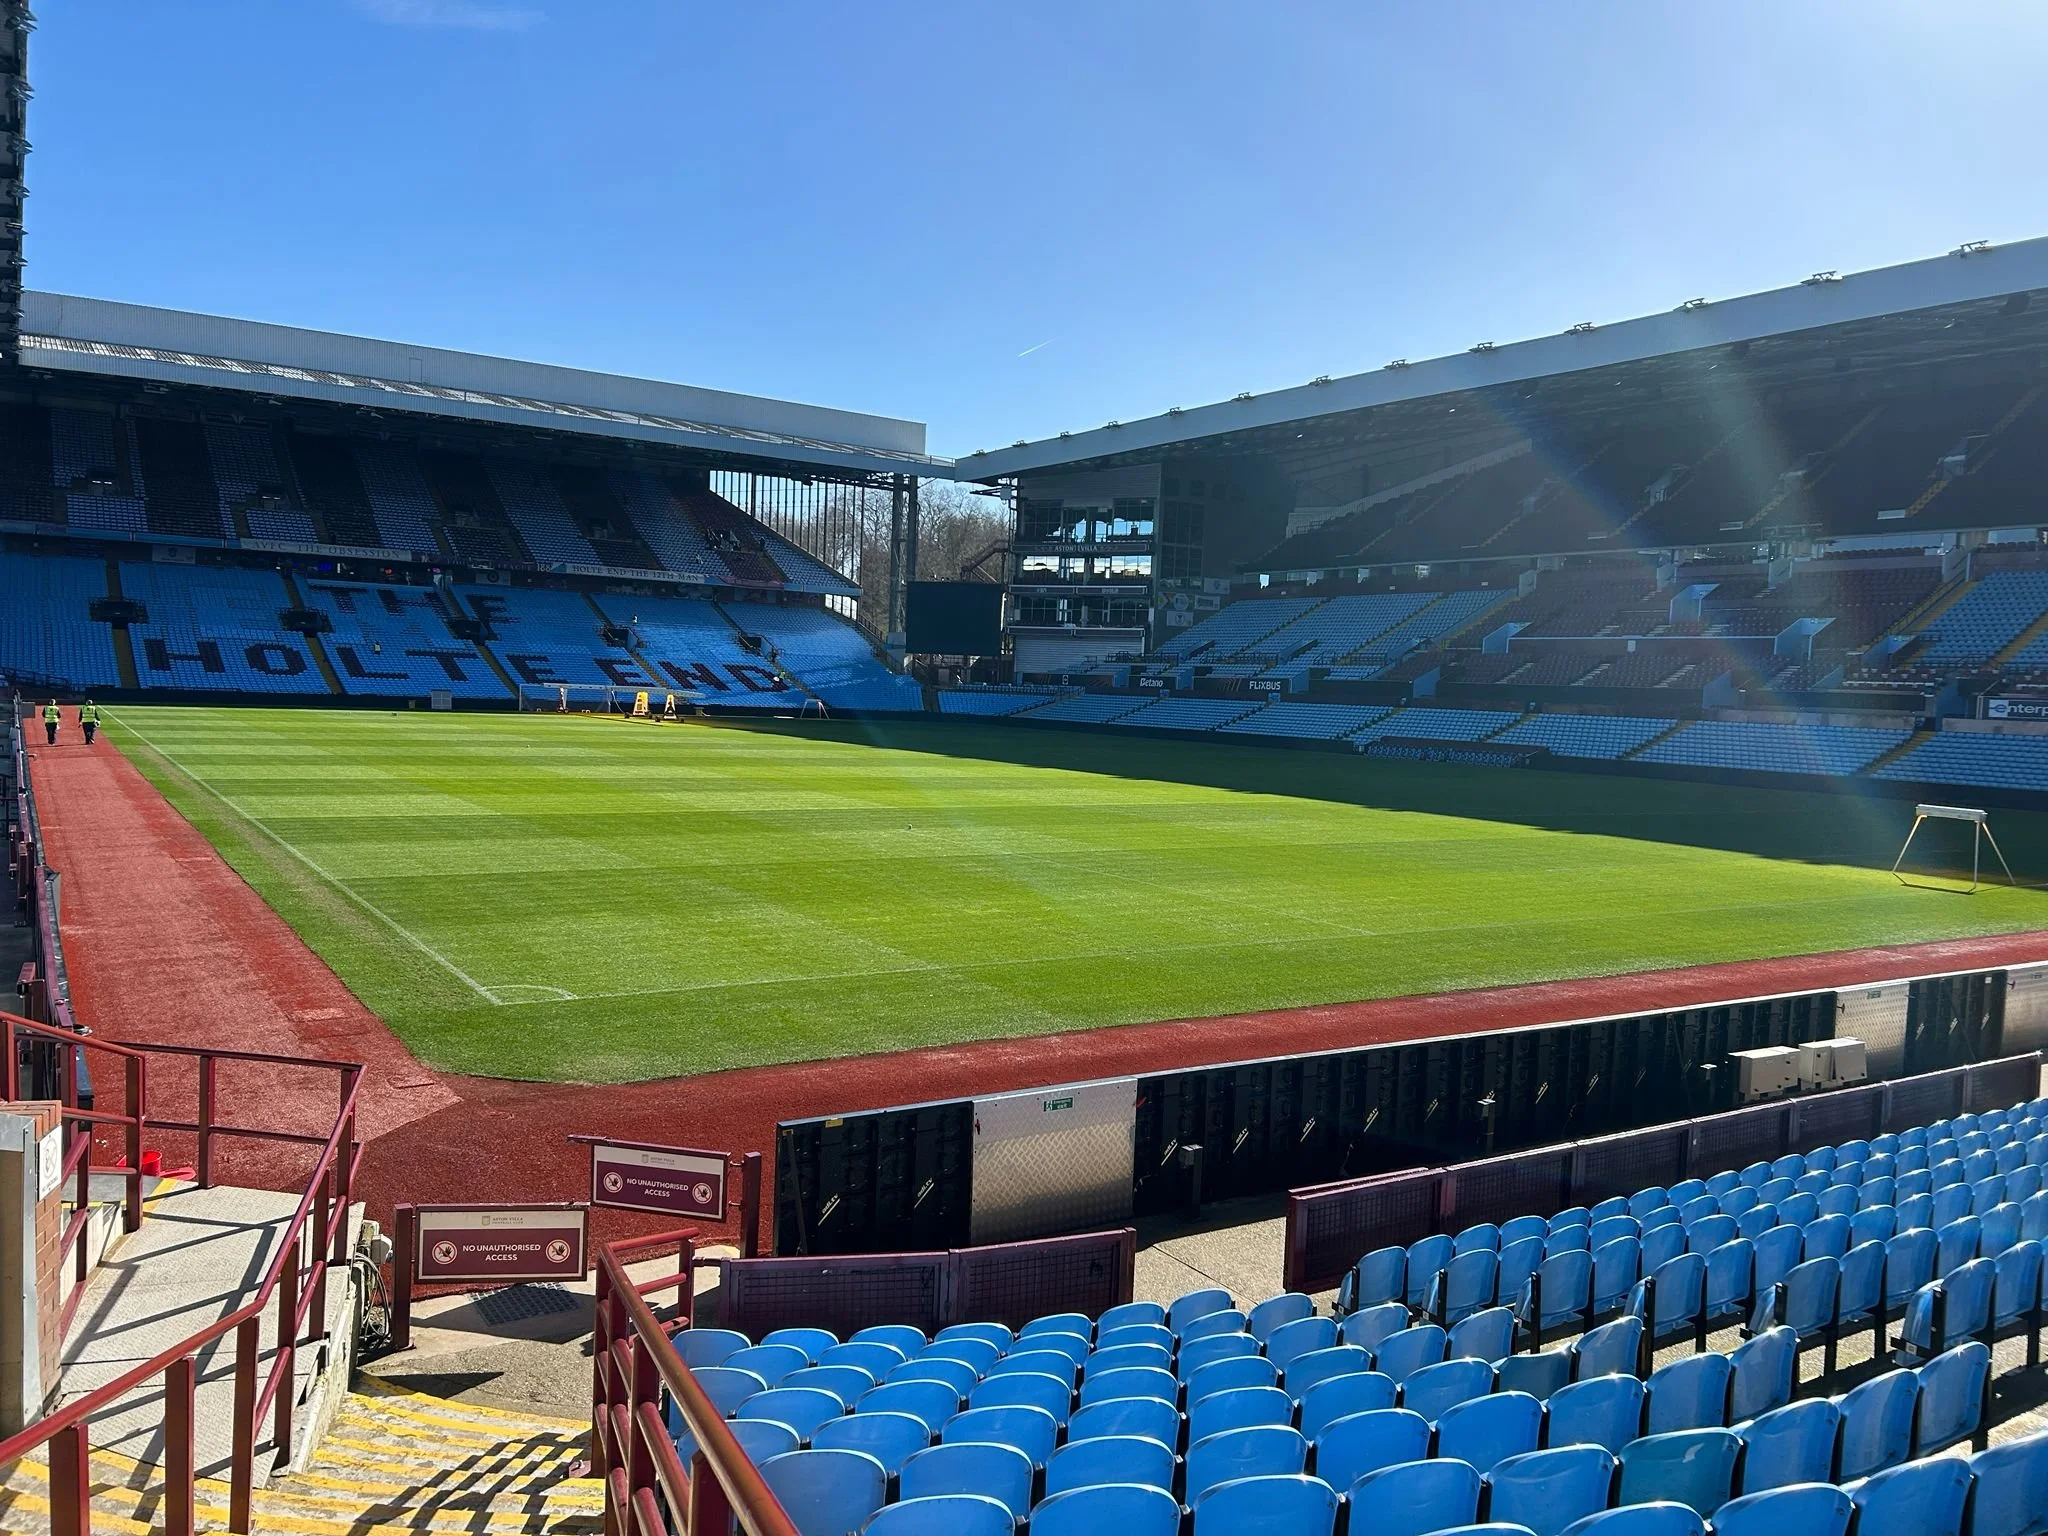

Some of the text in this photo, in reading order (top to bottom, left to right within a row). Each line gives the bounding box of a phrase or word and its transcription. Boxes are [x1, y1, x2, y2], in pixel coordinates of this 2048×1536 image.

[252, 541, 401, 559] AVFC THE OBSESSION
[1055, 544, 1074, 552] ASTON
[573, 565, 698, 582] HOLTE END THE 12TH MAN
[143, 637, 789, 692] HOLTE END
[1140, 678, 1164, 687] Betano
[637, 1179, 689, 1191] UNAUTHORISED
[644, 1189, 670, 1198] ACCESS
[477, 1244, 541, 1252] UNAUTHORISED
